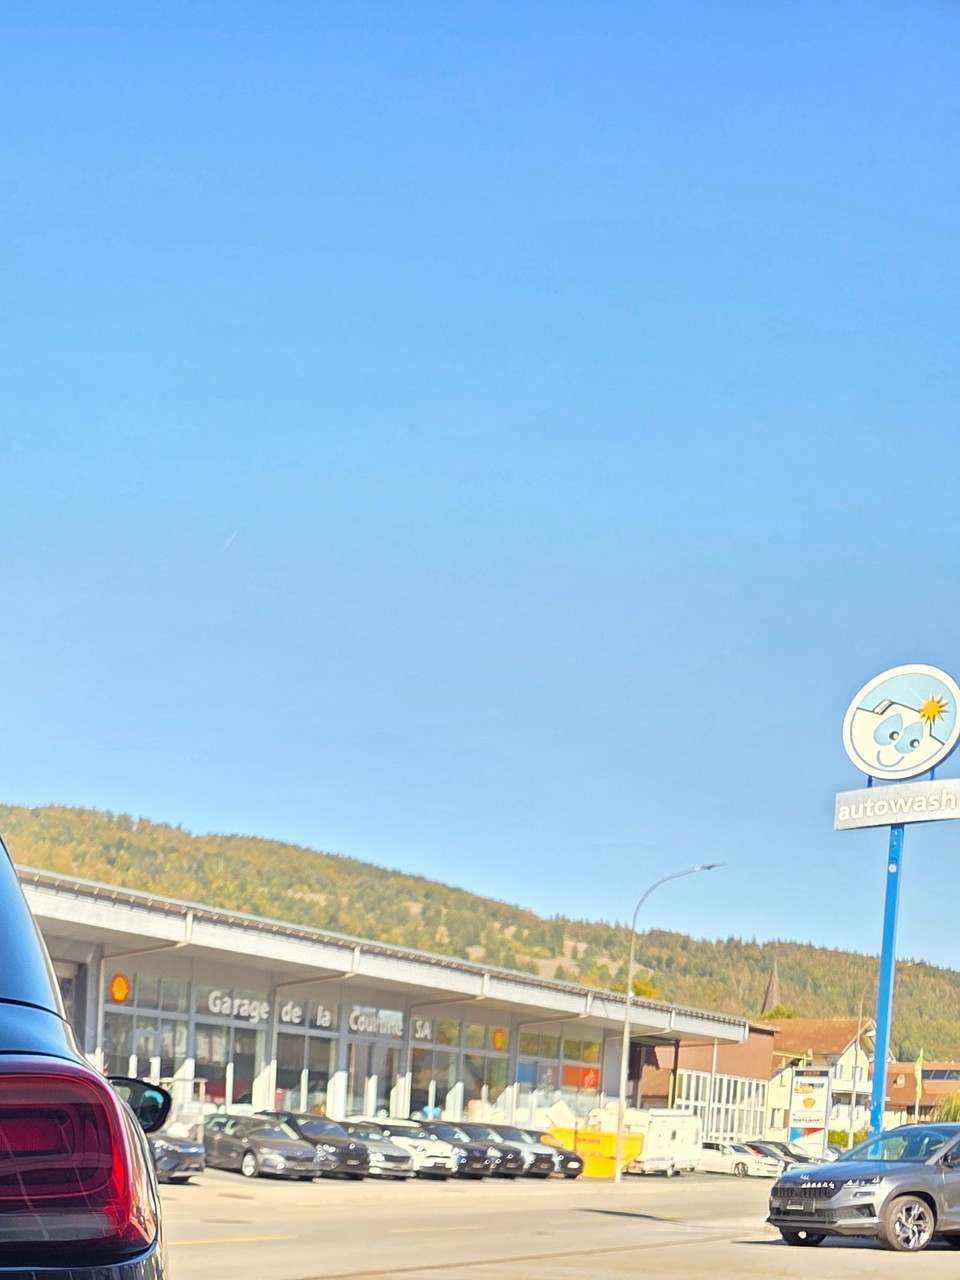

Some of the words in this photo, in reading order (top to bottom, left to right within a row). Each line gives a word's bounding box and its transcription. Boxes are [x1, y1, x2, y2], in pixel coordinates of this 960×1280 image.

[838, 788, 956, 820] autowash
[208, 991, 270, 1024] Garage
[281, 1000, 302, 1024] de
[316, 1005, 331, 1027] la
[415, 1018, 432, 1040] SA
